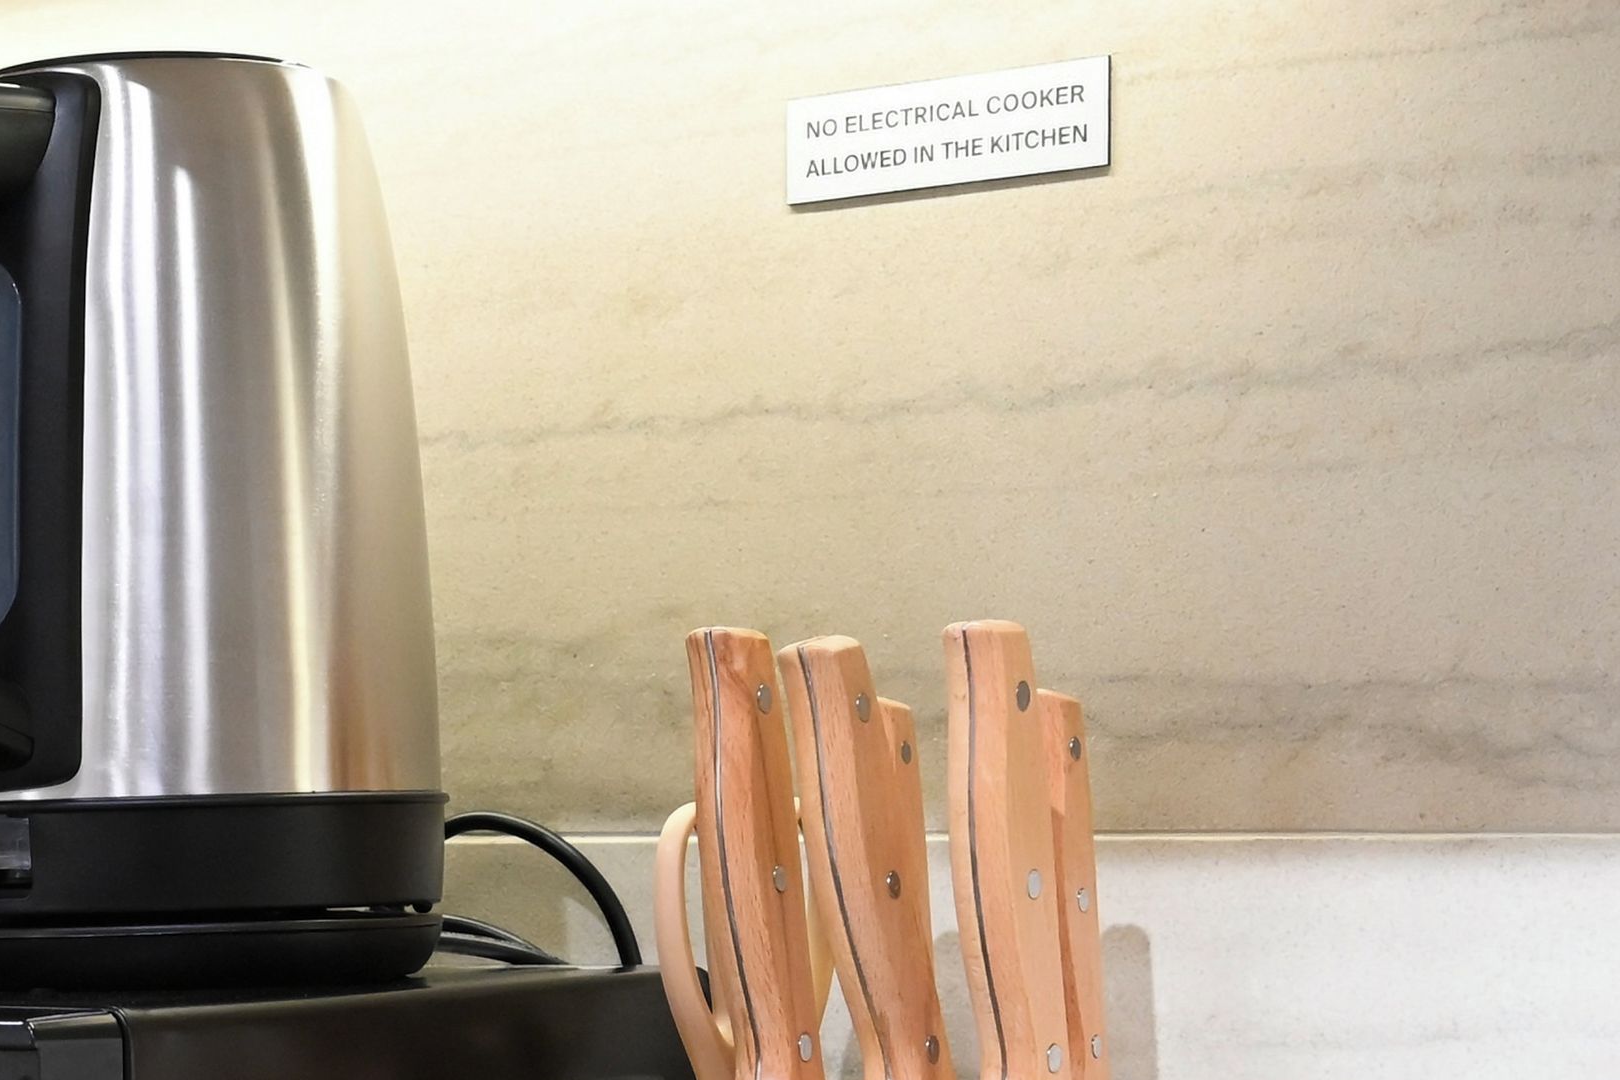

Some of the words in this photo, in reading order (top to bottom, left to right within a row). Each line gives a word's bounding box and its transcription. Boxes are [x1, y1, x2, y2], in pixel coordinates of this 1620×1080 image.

[807, 119, 837, 139] NO
[845, 100, 979, 134] ELECTRICAL
[987, 85, 1084, 114] COOKER
[806, 149, 907, 178] ALLOWED
[914, 145, 933, 163] IN
[942, 138, 983, 159] THE
[991, 124, 1088, 154] KITCHEN
